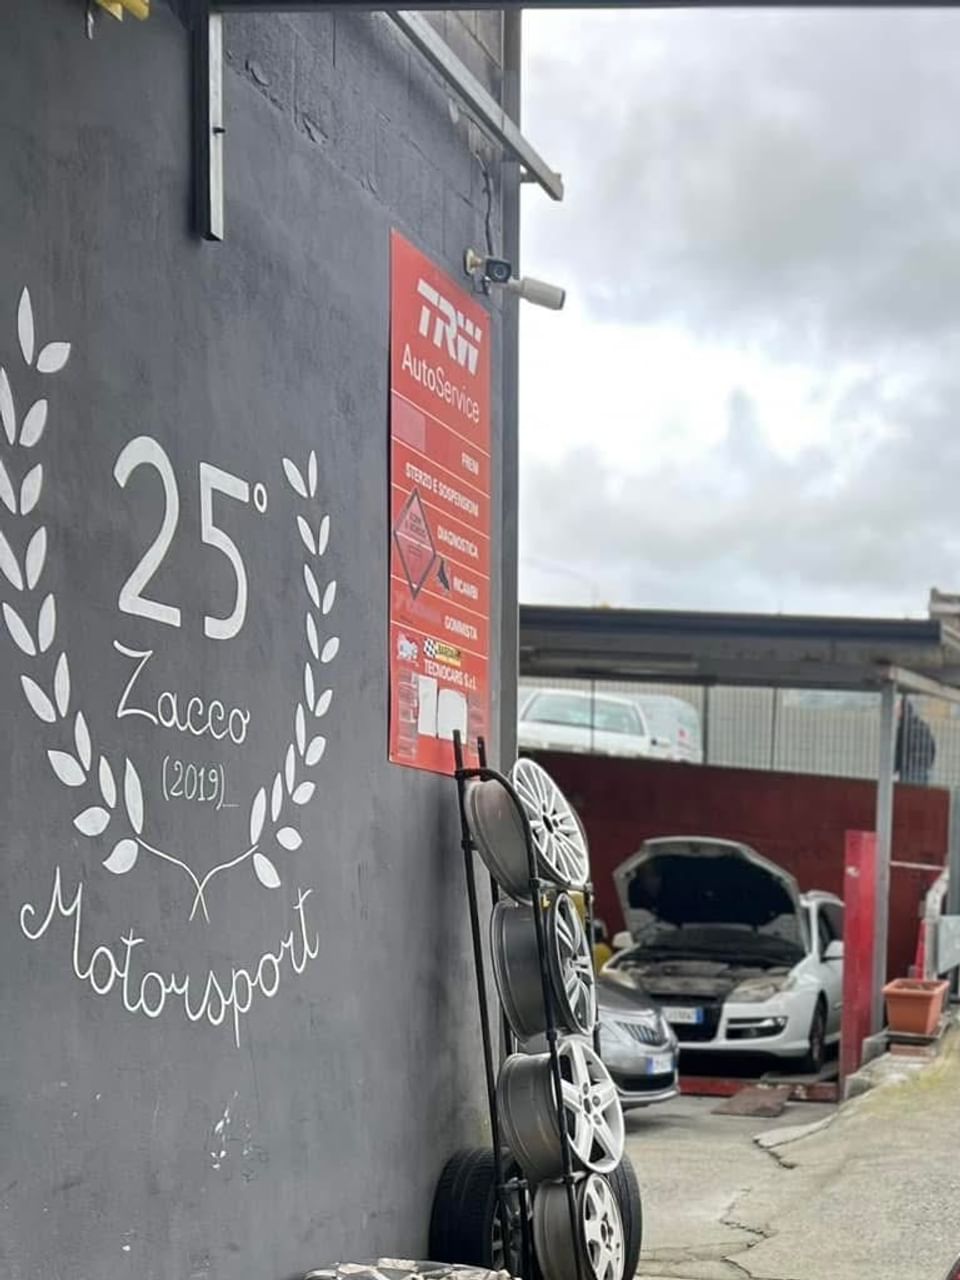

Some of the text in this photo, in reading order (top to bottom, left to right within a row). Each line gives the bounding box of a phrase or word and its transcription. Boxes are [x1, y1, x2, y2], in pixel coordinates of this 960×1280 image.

[416, 278, 483, 376] TRW
[401, 342, 480, 425] AutoService
[437, 525, 479, 559] DIAGNOSTICA
[113, 640, 251, 744] Zacco
[20, 866, 320, 1047] Motorsport
